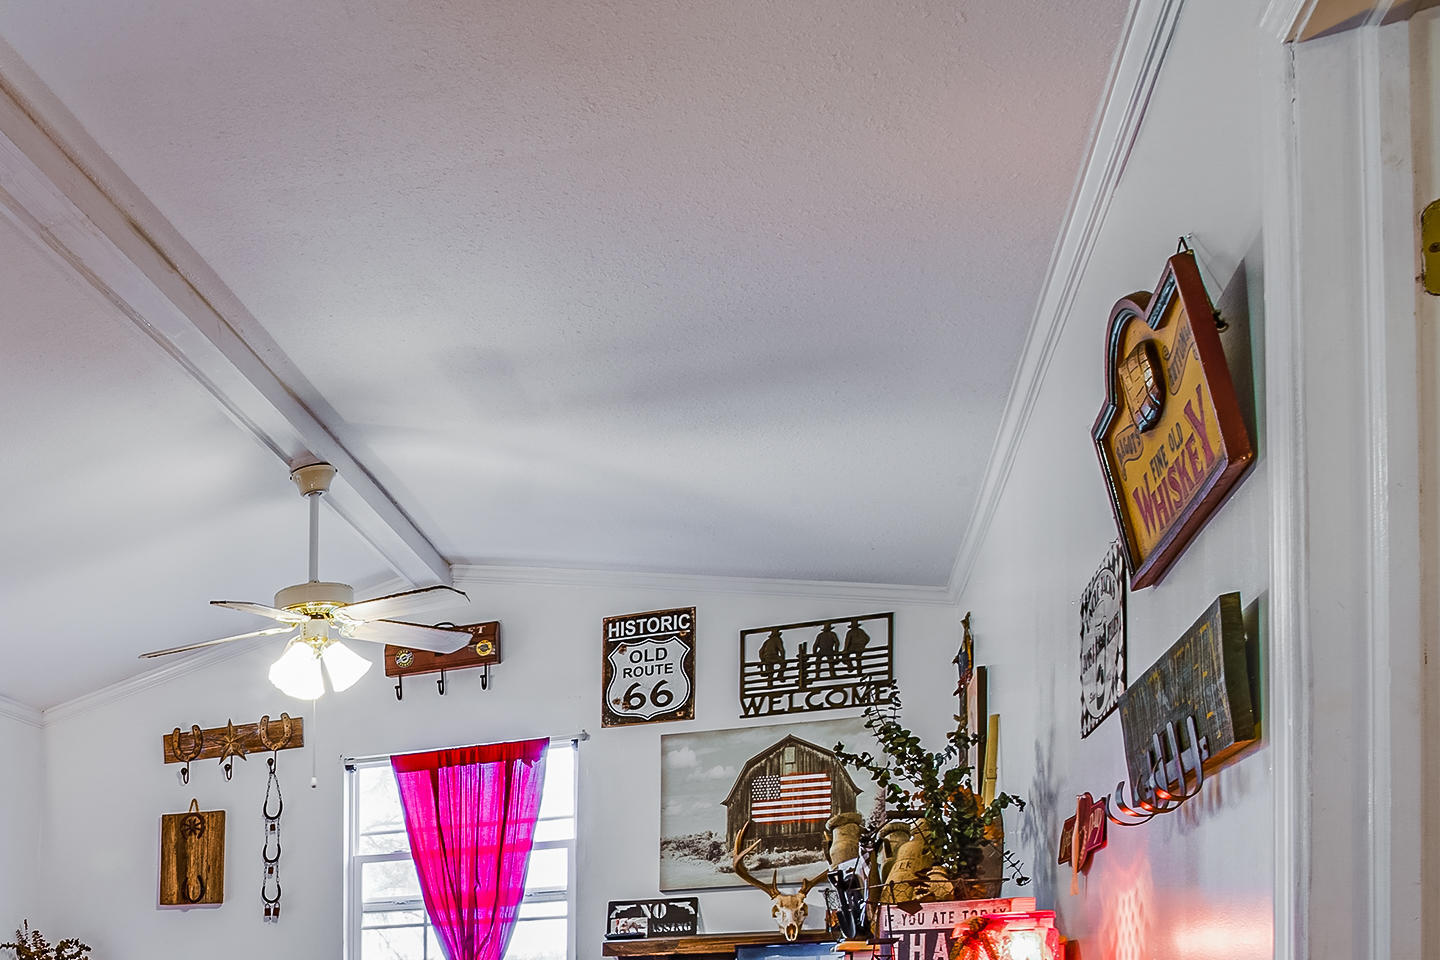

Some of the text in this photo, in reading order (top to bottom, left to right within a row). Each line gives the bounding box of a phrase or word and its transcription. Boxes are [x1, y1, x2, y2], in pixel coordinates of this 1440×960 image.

[1132, 383, 1215, 537] WHISKEY
[1149, 422, 1184, 482] FINE OLD
[608, 613, 691, 638] HISTORIC
[629, 647, 668, 664] OLD
[623, 662, 674, 679] ROUTE
[622, 679, 675, 711] 66
[741, 684, 895, 717] WELCOME
[640, 903, 667, 919] NO
[901, 912, 925, 927] YOU
[931, 910, 955, 925] ATE
